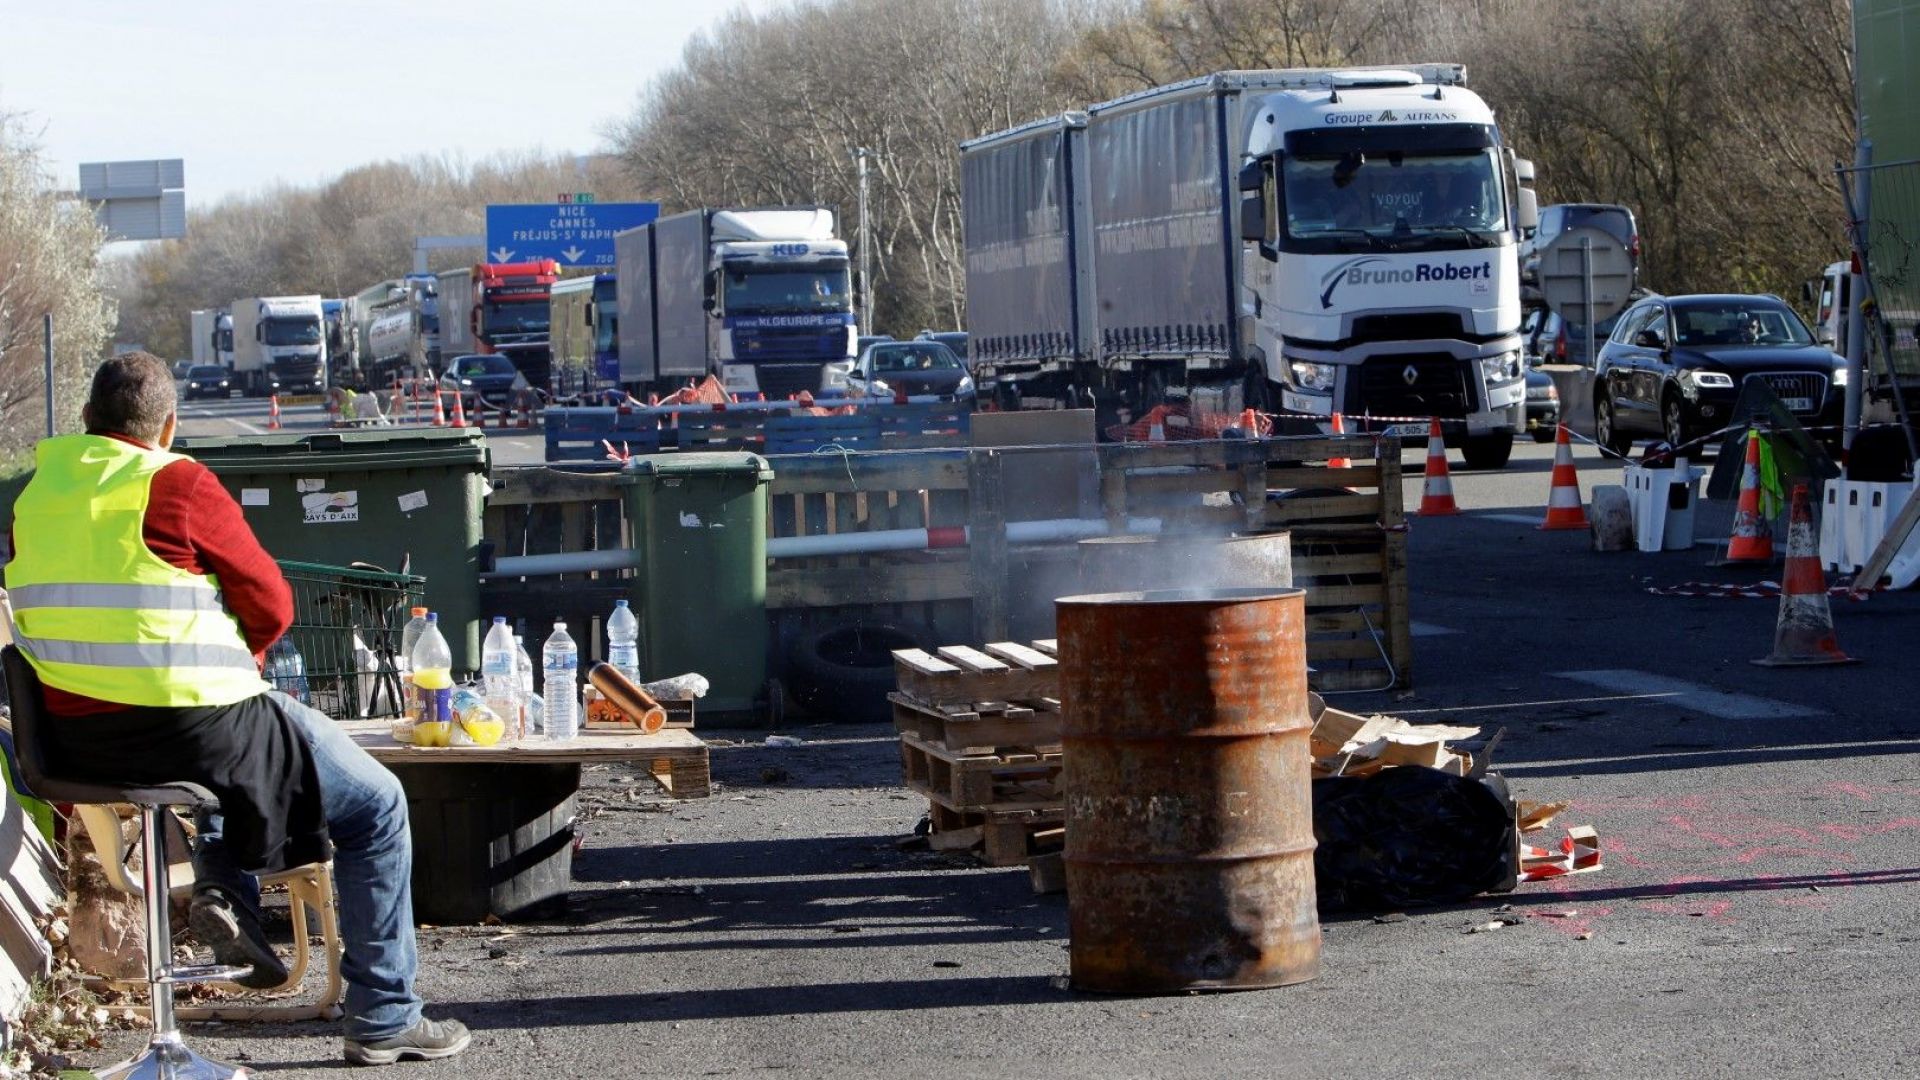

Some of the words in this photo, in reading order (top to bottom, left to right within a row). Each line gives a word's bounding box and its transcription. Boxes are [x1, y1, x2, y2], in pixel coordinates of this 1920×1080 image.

[1324, 112, 1373, 125] Groupe
[1403, 112, 1458, 121] ALTRANS
[558, 205, 586, 217] NICE
[549, 218, 596, 229] CANNES
[595, 254, 614, 263] 750
